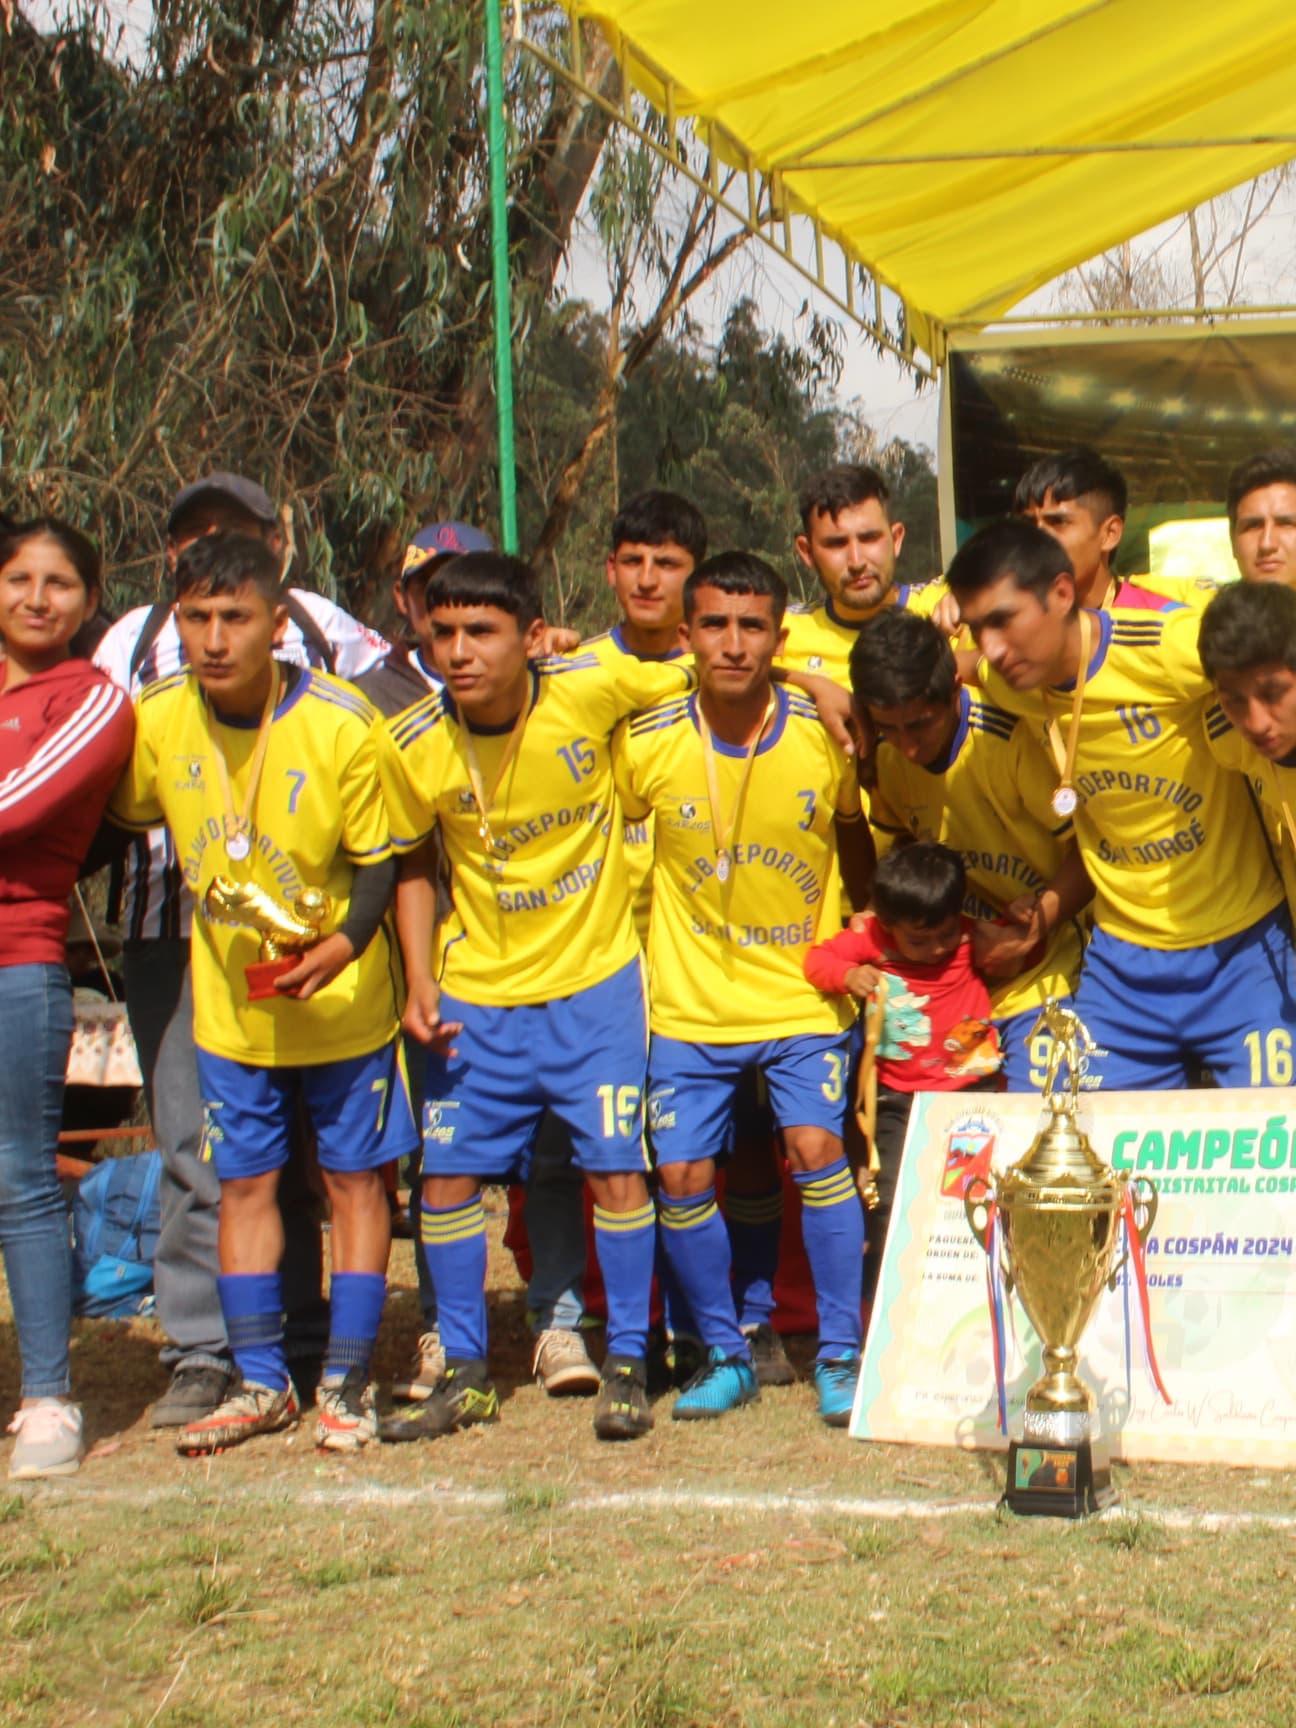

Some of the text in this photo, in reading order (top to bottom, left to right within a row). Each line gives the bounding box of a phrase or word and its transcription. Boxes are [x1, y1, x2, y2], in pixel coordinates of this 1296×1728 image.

[1115, 702, 1162, 745] 16
[557, 736, 597, 784] 15
[286, 769, 306, 816] 7
[797, 789, 817, 832] 3
[1077, 768, 1204, 814] DEPORTIVO
[509, 800, 614, 848] DEPORT
[722, 842, 822, 906] EPORTIVO
[499, 888, 548, 913] SAN
[736, 914, 816, 948] JORGÉ
[821, 1052, 842, 1102] 3
[1243, 1027, 1294, 1088] 16
[371, 1077, 389, 1132] 7
[1150, 1175, 1250, 1194] DISTRITAL
[1163, 1231, 1293, 1257] COSPÁN 2024
[1146, 1273, 1184, 1289] OLES
